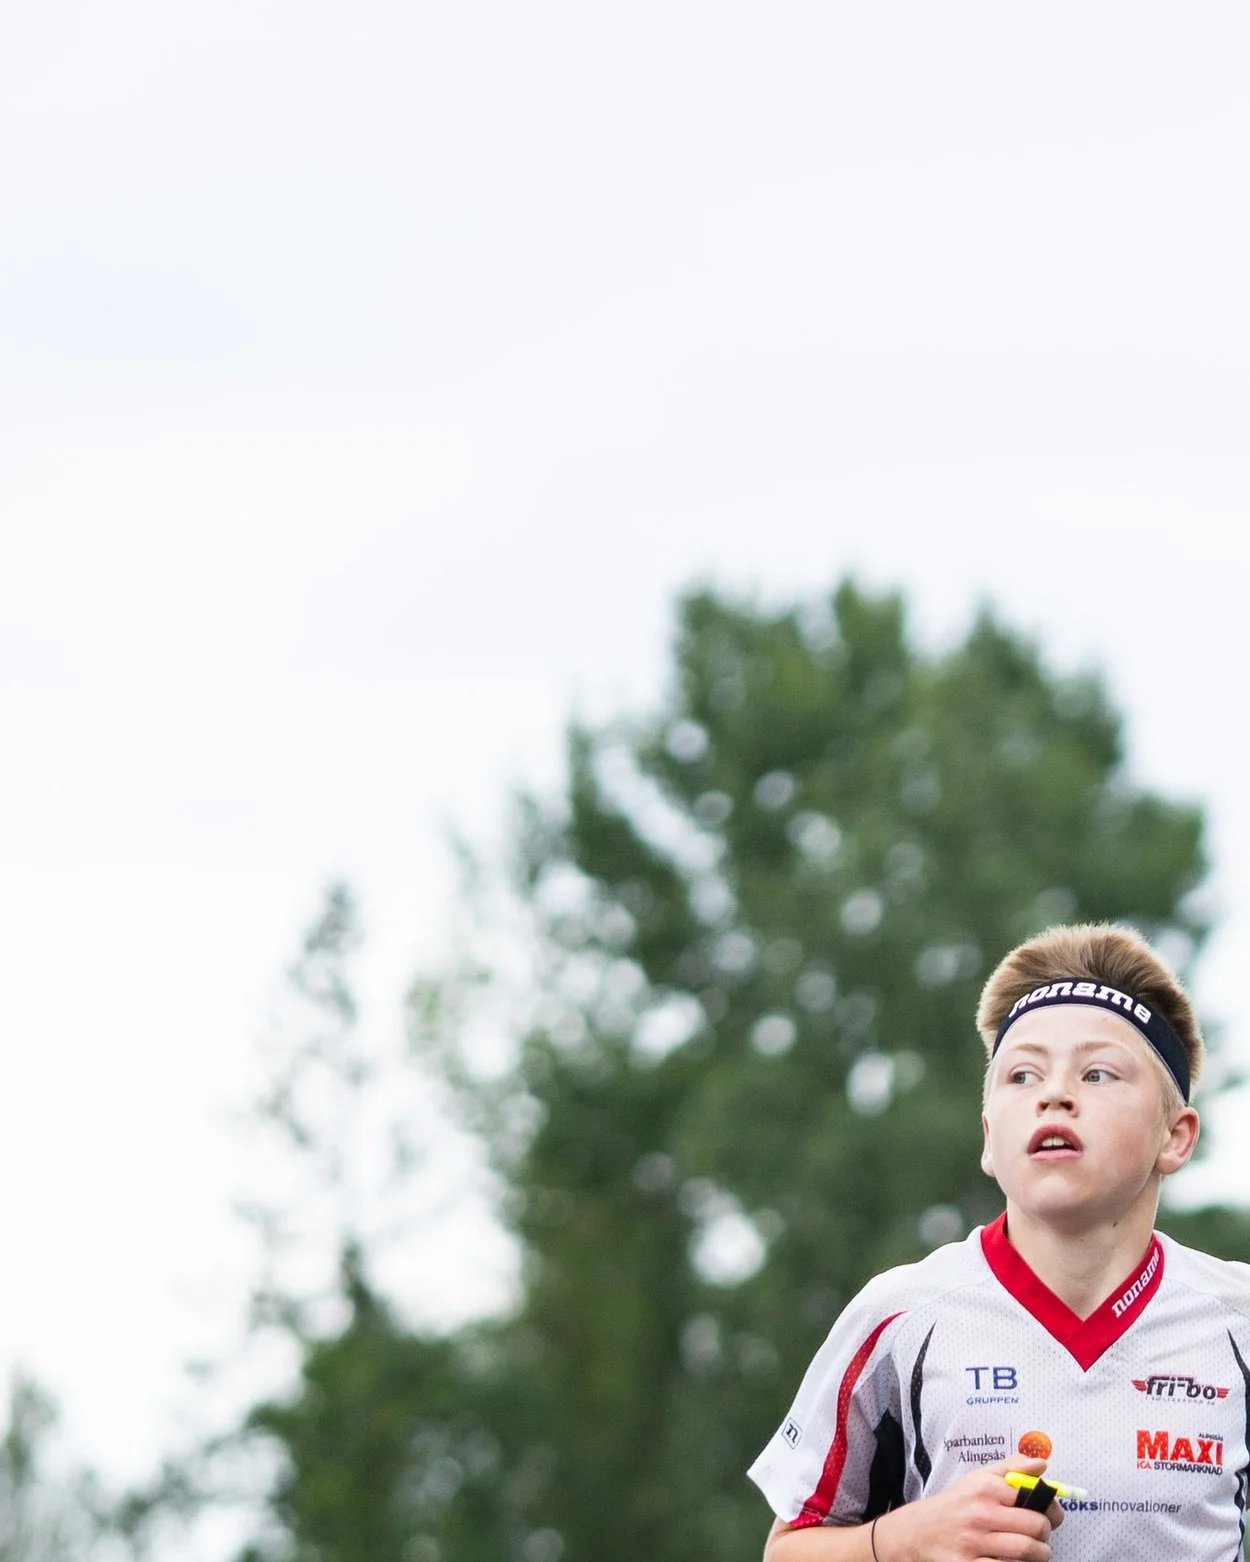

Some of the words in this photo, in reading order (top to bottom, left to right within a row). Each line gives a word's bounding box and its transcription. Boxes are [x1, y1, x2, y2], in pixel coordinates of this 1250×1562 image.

[1008, 981, 1152, 1025] noname
[965, 1366, 1018, 1391] TB
[1146, 1375, 1217, 1400] fri-bo
[966, 1396, 1019, 1406] GRUPPEN
[957, 1448, 1006, 1465] Alingsås
[1136, 1429, 1223, 1466] MAXI
[1153, 1460, 1223, 1477] STORMARKNAD
